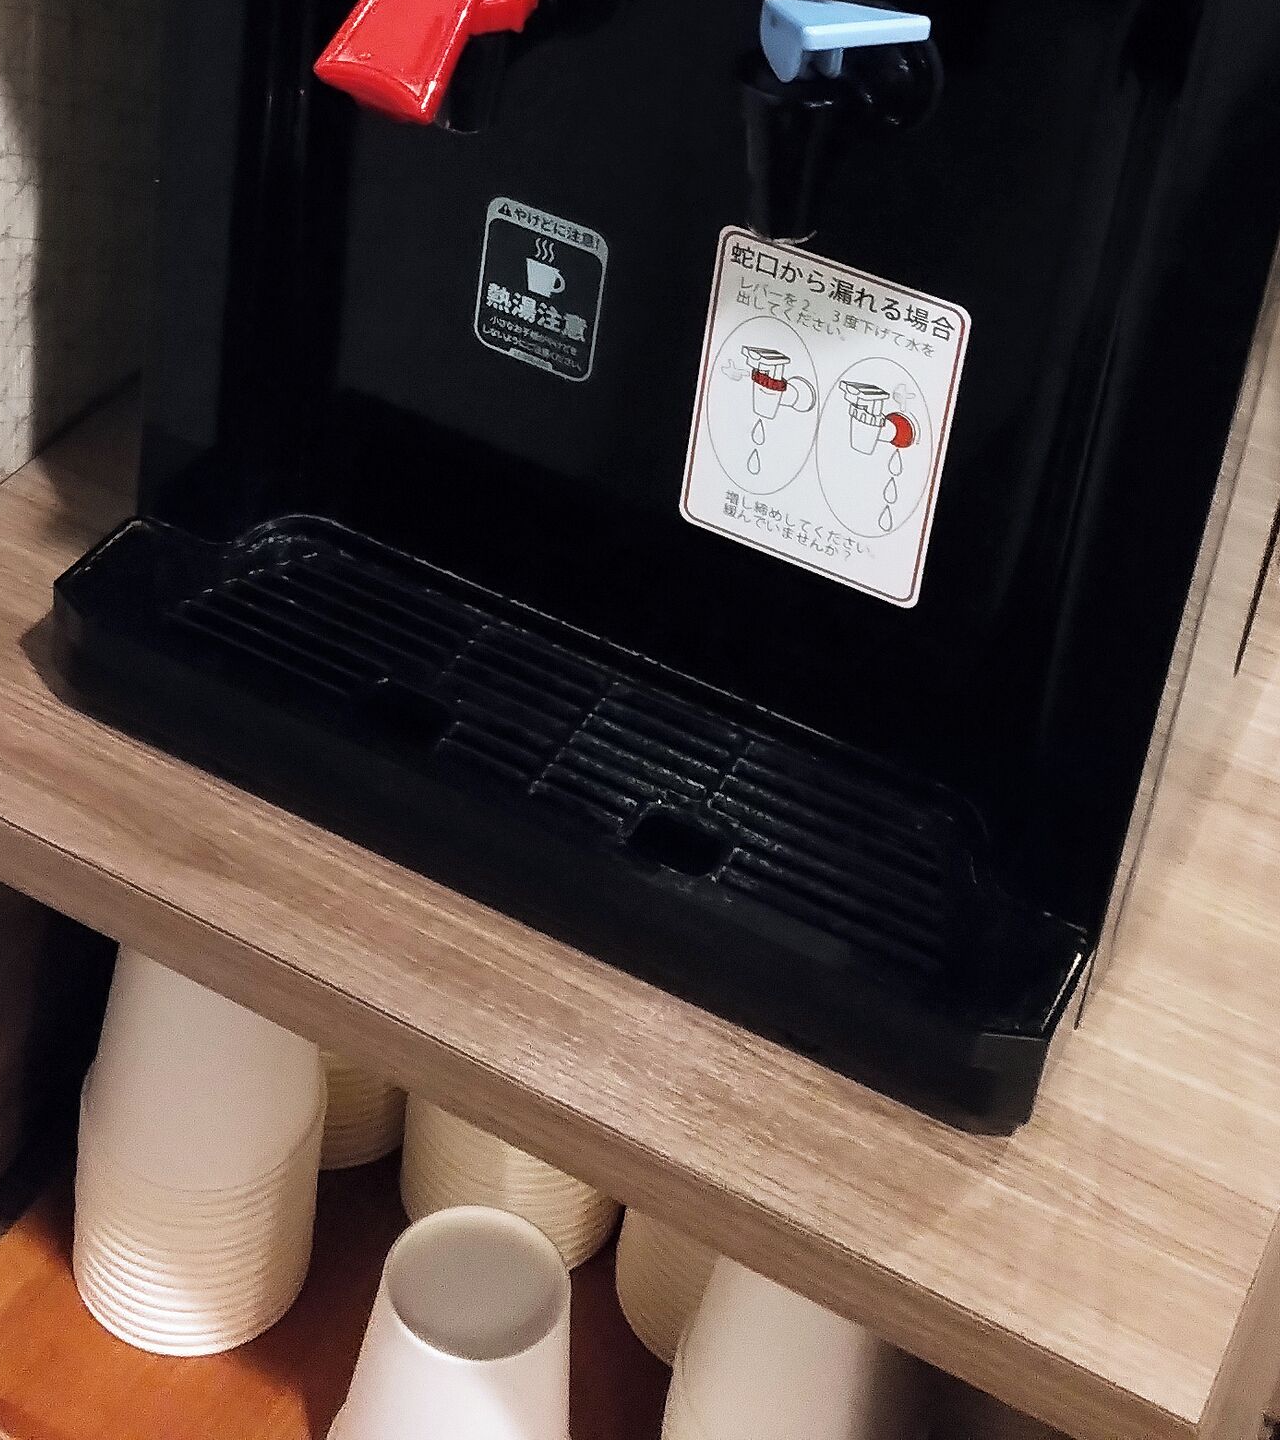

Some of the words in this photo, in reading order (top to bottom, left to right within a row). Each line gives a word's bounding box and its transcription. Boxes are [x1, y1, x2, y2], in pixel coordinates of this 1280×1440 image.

[485, 282, 588, 343] 熱湯注意
[729, 241, 957, 343] 蛇口から漏れる場合
